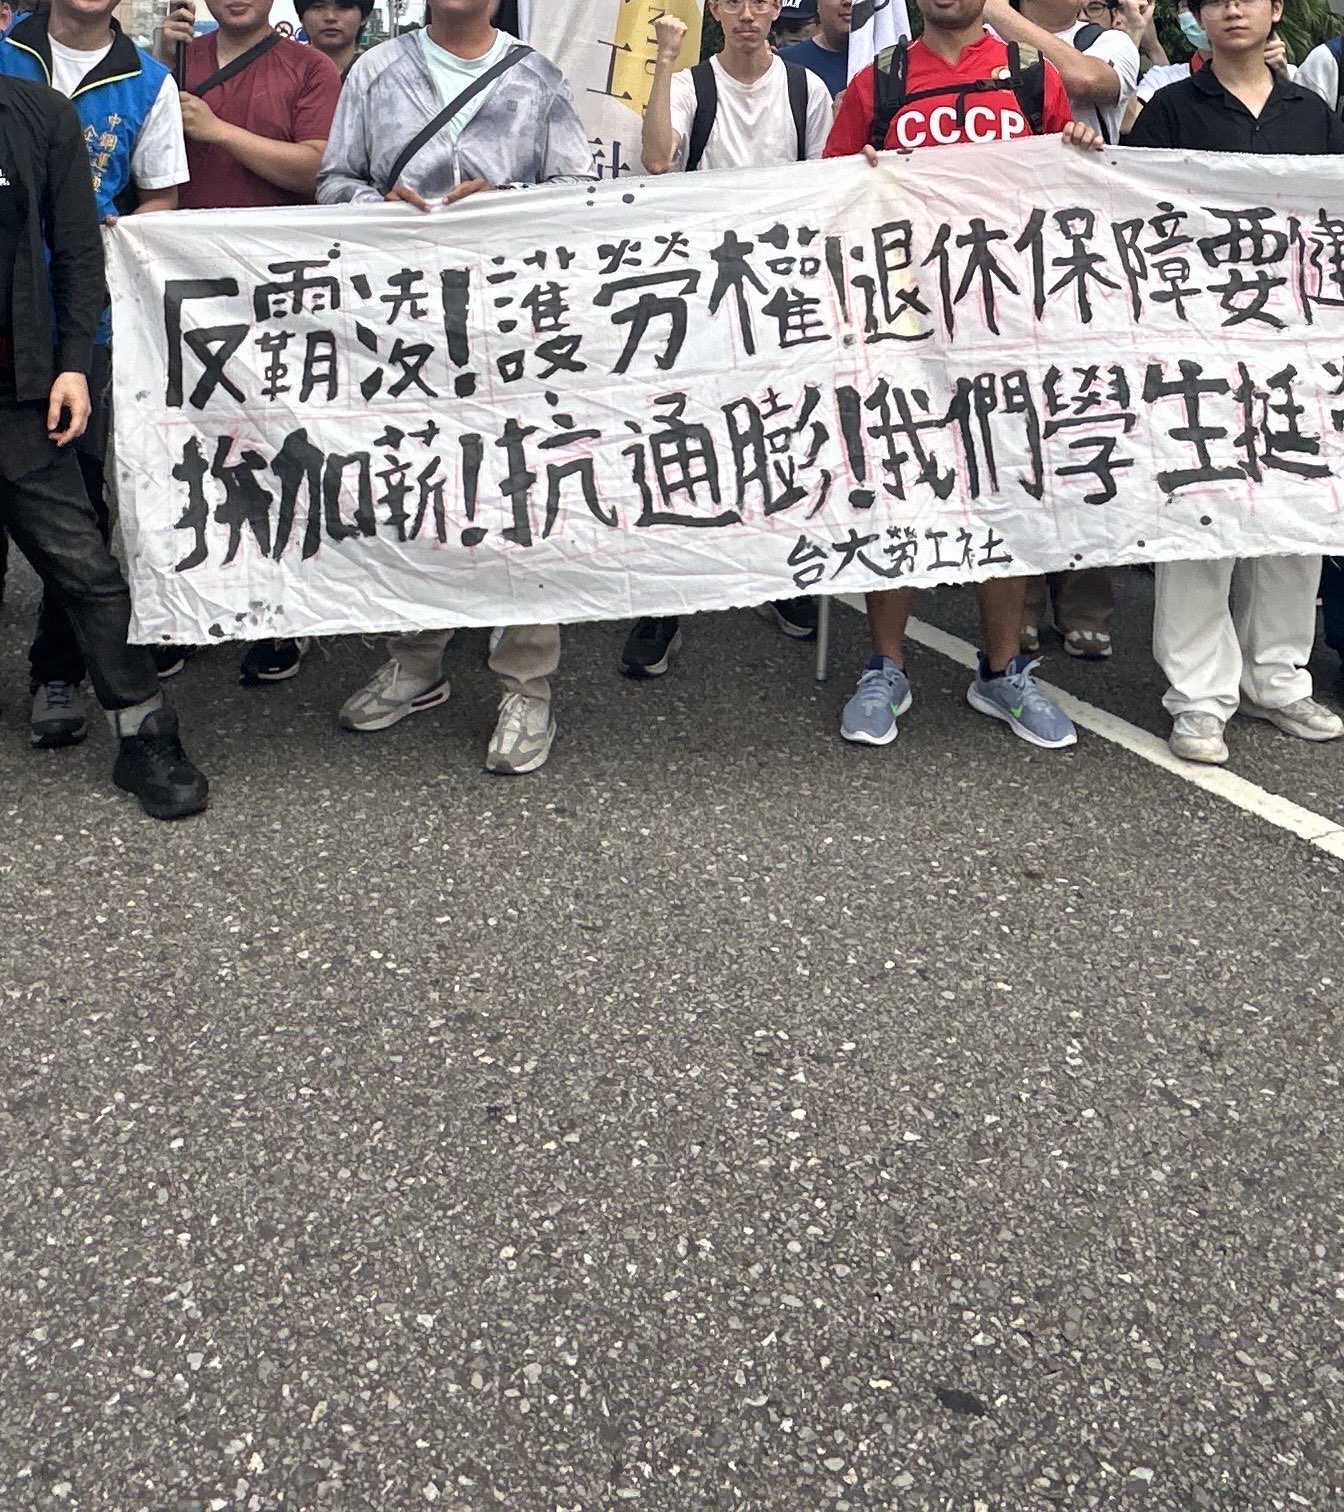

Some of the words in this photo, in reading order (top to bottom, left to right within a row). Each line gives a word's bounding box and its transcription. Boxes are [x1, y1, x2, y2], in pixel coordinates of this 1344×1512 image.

[896, 106, 1025, 148] CCCP
[787, 526, 1014, 589] 台大勞工社
